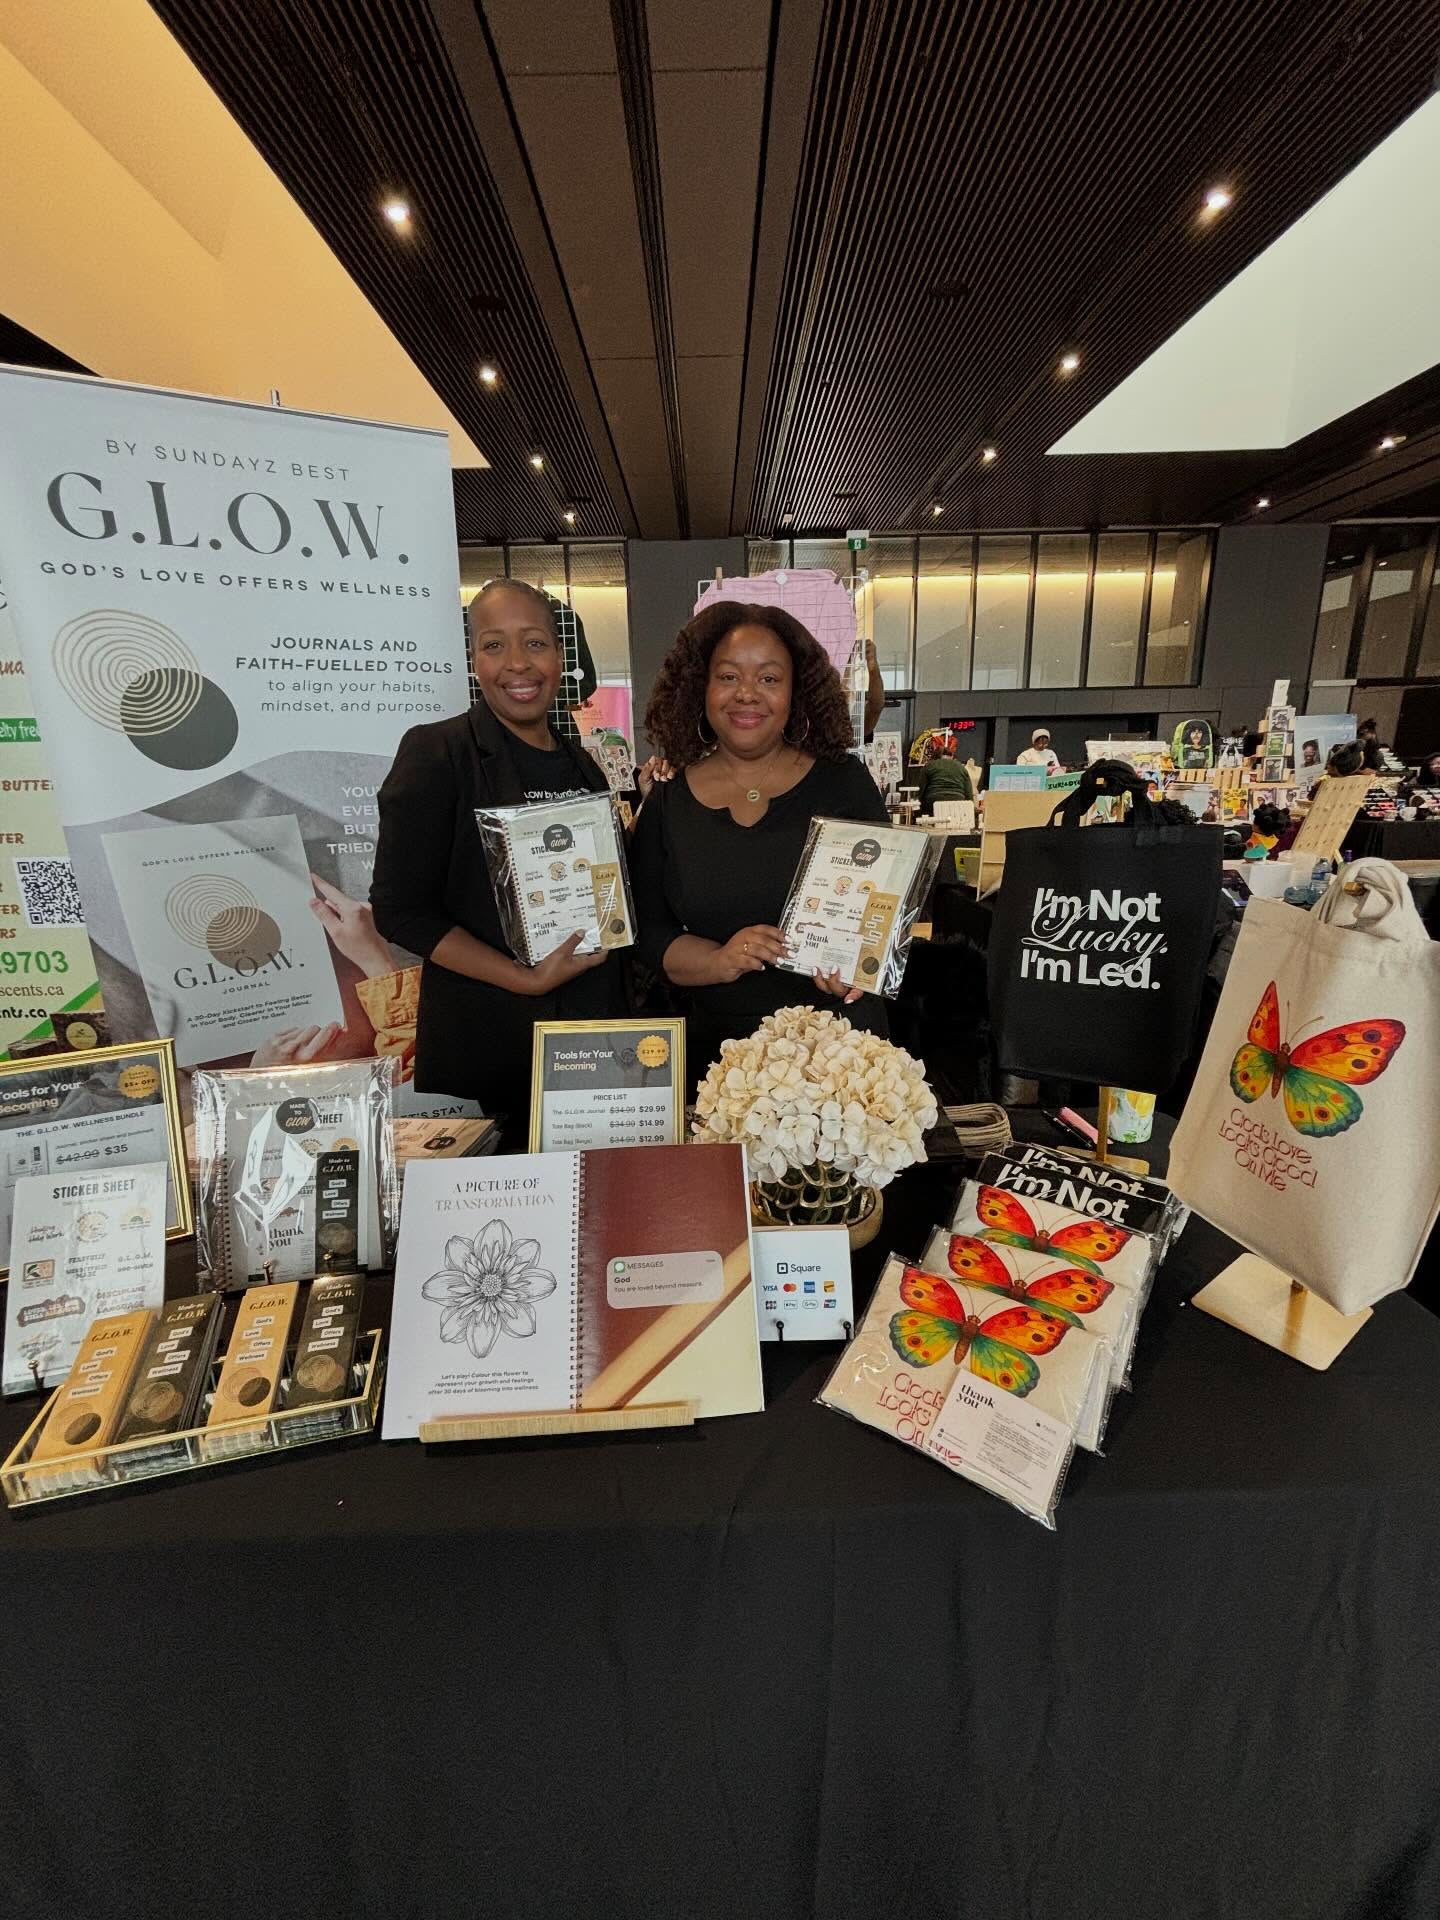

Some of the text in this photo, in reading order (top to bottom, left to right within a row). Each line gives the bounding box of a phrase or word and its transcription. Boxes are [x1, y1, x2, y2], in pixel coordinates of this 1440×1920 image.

[106, 439, 349, 481] BY SUNDAYZ BEST
[47, 472, 409, 564] G.L.O.W.
[40, 561, 431, 598] GOD'S LOVE OFFERS WELLNESS
[270, 637, 418, 652] JOURNALS AND
[236, 657, 453, 674] FAITH-FUELLED TOOLS
[268, 680, 435, 694] to align your habits,
[261, 700, 446, 714] mindset, and purpose.
[2, 779, 54, 791] BUTTE
[344, 823, 376, 835] BUT
[326, 842, 375, 855] TRIED
[1033, 887, 1162, 923] I'm Not
[1020, 900, 1168, 974] Lucky.
[0, 950, 69, 974] 9703
[173, 948, 305, 989] G.L.O.W.
[1020, 948, 1161, 990] I'm Led.
[222, 981, 271, 995] JOURNAL
[554, 1049, 614, 1060] Tools for Your
[554, 1061, 597, 1072] Becoming
[31, 1086, 50, 1096] for
[51, 1082, 82, 1093] Your
[613, 1093, 628, 1101] LIST
[432, 1105, 464, 1117] STAY
[639, 1105, 666, 1113] $29.99
[73, 1117, 115, 1129] WELLNESS
[115, 1111, 145, 1121] BUNDLE
[285, 1116, 313, 1128] GLOW
[318, 1113, 344, 1124] SHEET
[639, 1119, 665, 1127] $14.99
[639, 1135, 665, 1143] $12.99
[104, 1144, 129, 1157] $35
[1217, 1119, 1319, 1189] Looks Good
[1271, 1131, 1313, 1165] Love
[1234, 1148, 1287, 1192] On Me
[52, 1178, 136, 1200] STICKER SHEET
[465, 1178, 520, 1193] PICTURE
[522, 1177, 541, 1189] OF
[995, 1163, 1130, 1224] I'm Not
[435, 1193, 556, 1211] TRANSFORMATION
[268, 1226, 305, 1239] thank
[268, 1238, 291, 1251] you
[627, 1260, 664, 1270] MESSAGES
[790, 1263, 822, 1274] Square
[614, 1276, 631, 1284] God
[637, 1283, 655, 1291] loved
[655, 1282, 677, 1290] beyond
[763, 1284, 779, 1292] VISA
[955, 1393, 980, 1410] you
[960, 1384, 997, 1409] thank
[876, 1385, 932, 1427] Looks
[896, 1417, 925, 1449] On
